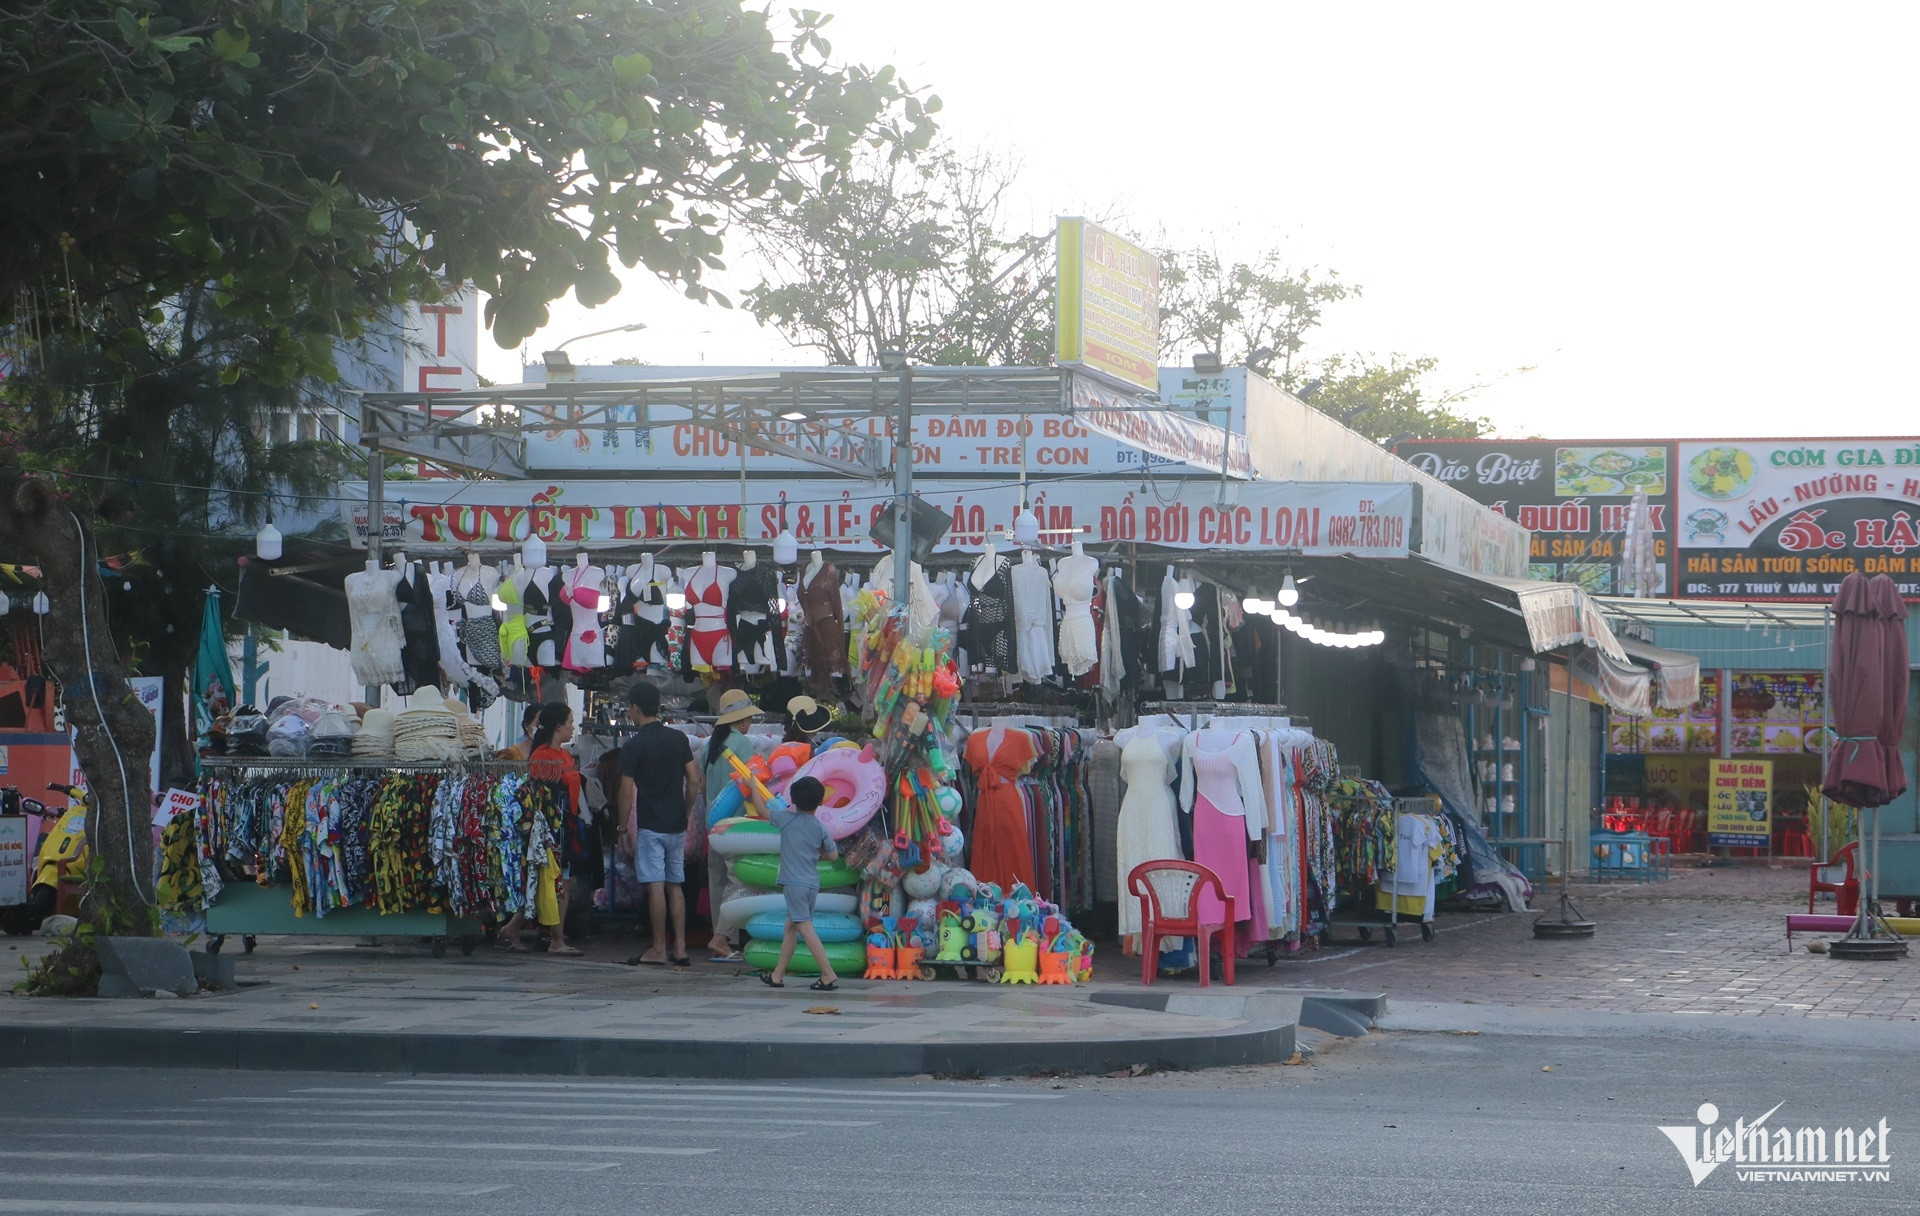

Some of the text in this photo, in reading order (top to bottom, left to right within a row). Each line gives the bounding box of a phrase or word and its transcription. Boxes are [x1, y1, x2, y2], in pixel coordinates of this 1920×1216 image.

[1036, 446, 1089, 465] CON
[1117, 450, 1138, 463] ĐT:
[1770, 446, 1826, 467] CƠM
[1837, 448, 1886, 467] GIA
[1476, 452, 1543, 486] Biệt
[1359, 500, 1375, 513] ĐT:
[1737, 496, 1780, 535] LẨU
[1793, 472, 1878, 503] NƯỚNG
[410, 485, 600, 542] TUYẾT
[608, 504, 748, 540] LINH
[796, 504, 815, 544] &
[824, 490, 861, 545] LẺ:
[949, 496, 985, 546] ÁO
[1100, 491, 1136, 542] ĐỒ
[1145, 501, 1189, 543] BƠI
[1517, 497, 1591, 532] ĐUỐI
[1328, 515, 1404, 548] 0982.783.019
[1552, 533, 1587, 557] SẢN
[1687, 552, 1718, 573] HẢI
[1721, 552, 1758, 573] SẢN
[1761, 555, 1802, 573] TƯƠI
[1687, 583, 1711, 593] ĐC:
[1718, 583, 1739, 593] 177
[1788, 582, 1817, 593] VÂN
[170, 793, 195, 806] CHO
